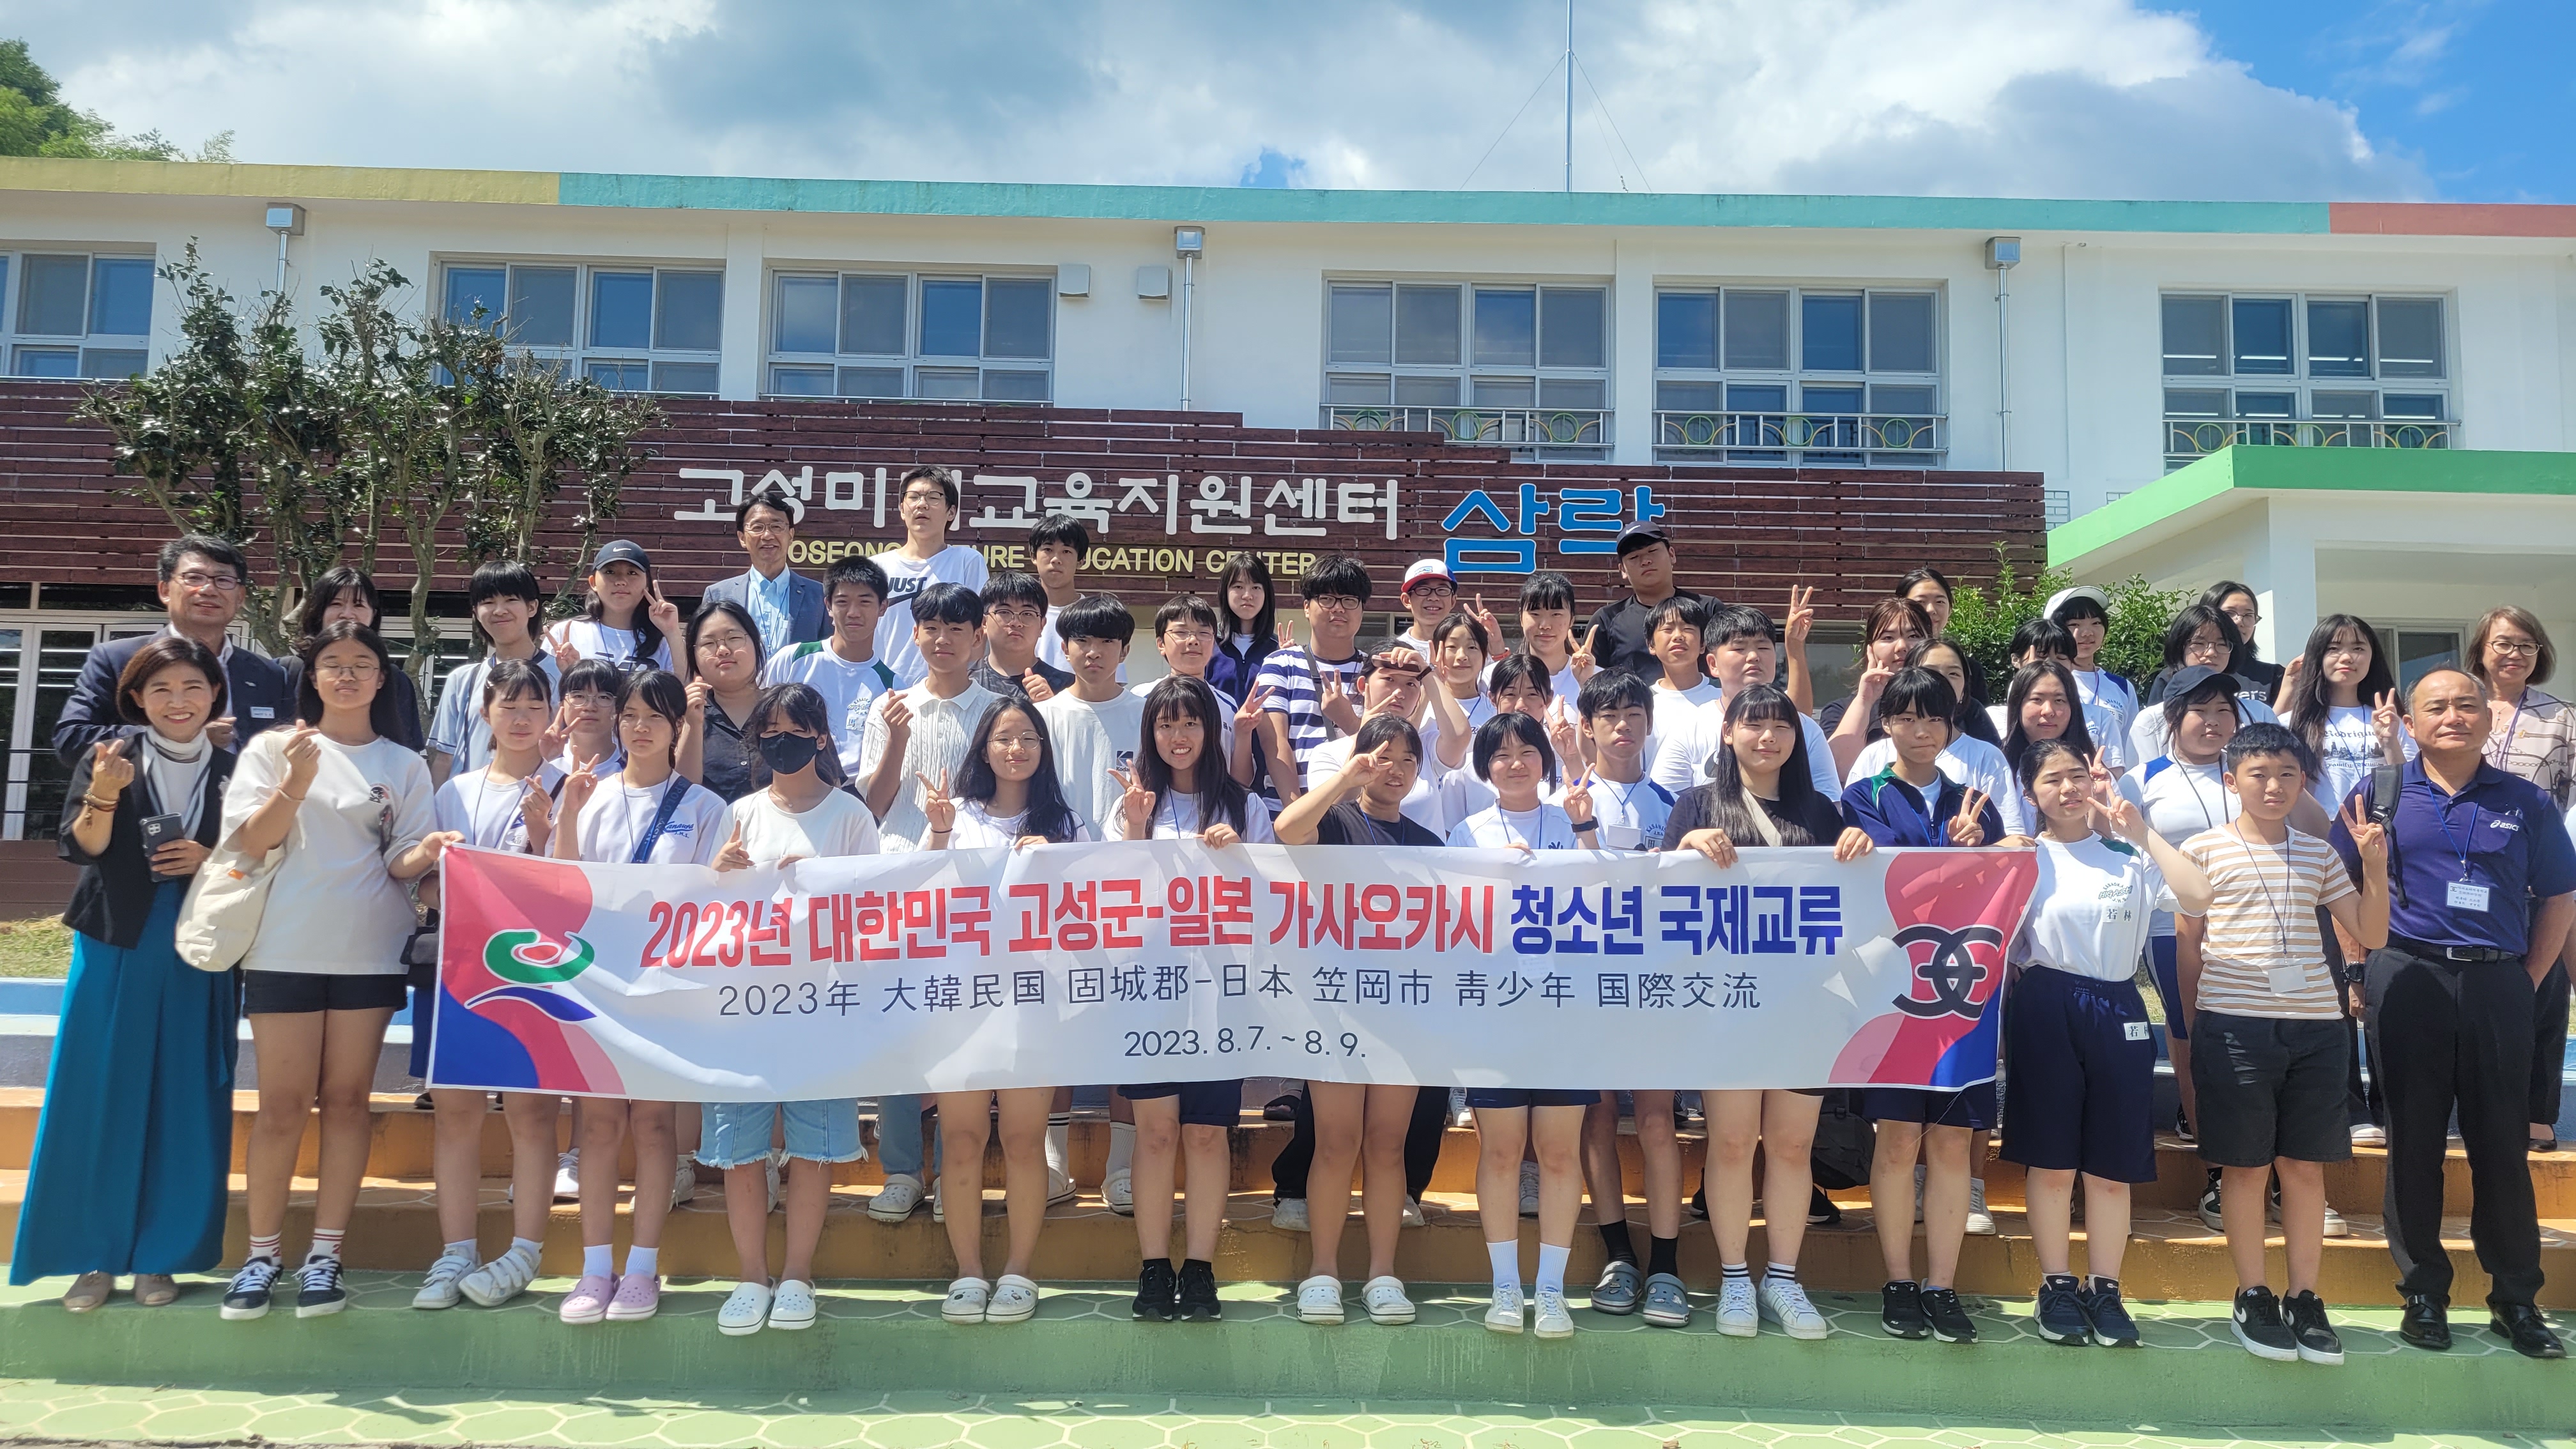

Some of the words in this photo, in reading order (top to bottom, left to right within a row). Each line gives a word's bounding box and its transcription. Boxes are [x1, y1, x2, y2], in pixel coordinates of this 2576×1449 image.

[674, 466, 1398, 540] 고성미교육지원센터
[788, 540, 902, 565] OSEON
[1078, 547, 1193, 573] UCATION
[1206, 549, 1317, 575] CTER
[887, 577, 928, 593] JUST
[641, 898, 792, 968] 2023년
[809, 886, 990, 962] 대한민국
[1008, 875, 1254, 953] 고성군-일본
[1269, 881, 1494, 953] 가사오카시
[1510, 885, 1644, 955] 청소년
[1660, 885, 1843, 956] 국제교류
[719, 980, 861, 1016] 2023年
[1312, 966, 1433, 1006] 笠岡市
[1597, 971, 1761, 1009] 国際交流
